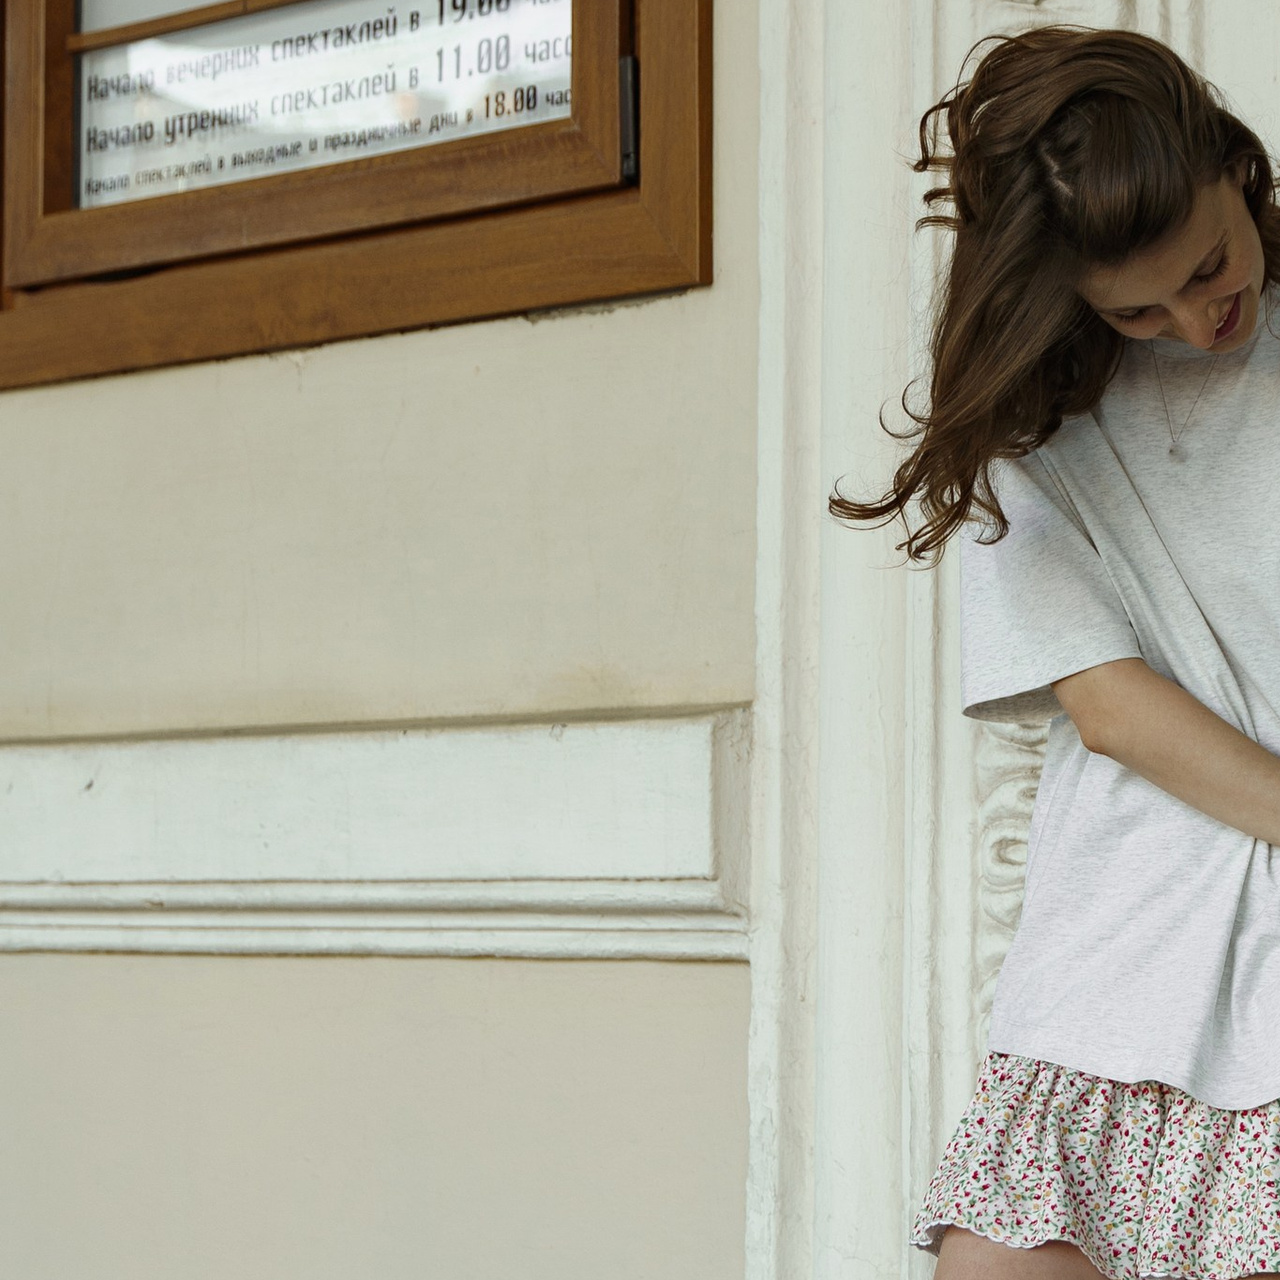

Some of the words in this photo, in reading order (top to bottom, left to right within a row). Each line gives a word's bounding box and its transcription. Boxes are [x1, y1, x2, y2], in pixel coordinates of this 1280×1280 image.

[86, 120, 154, 153] Начало
[165, 100, 259, 145] утренних
[271, 63, 396, 116] спектаклей
[409, 67, 419, 88] в
[436, 34, 510, 83] 11.00
[87, 69, 154, 101] Начало
[166, 44, 260, 84] вечерних
[272, 7, 397, 62] спектаклей
[410, 10, 420, 32] в
[84, 173, 130, 196] Начало
[135, 154, 212, 185] спектаклей
[308, 137, 318, 153] и
[428, 111, 458, 135] дни
[484, 84, 537, 119] 18.00
